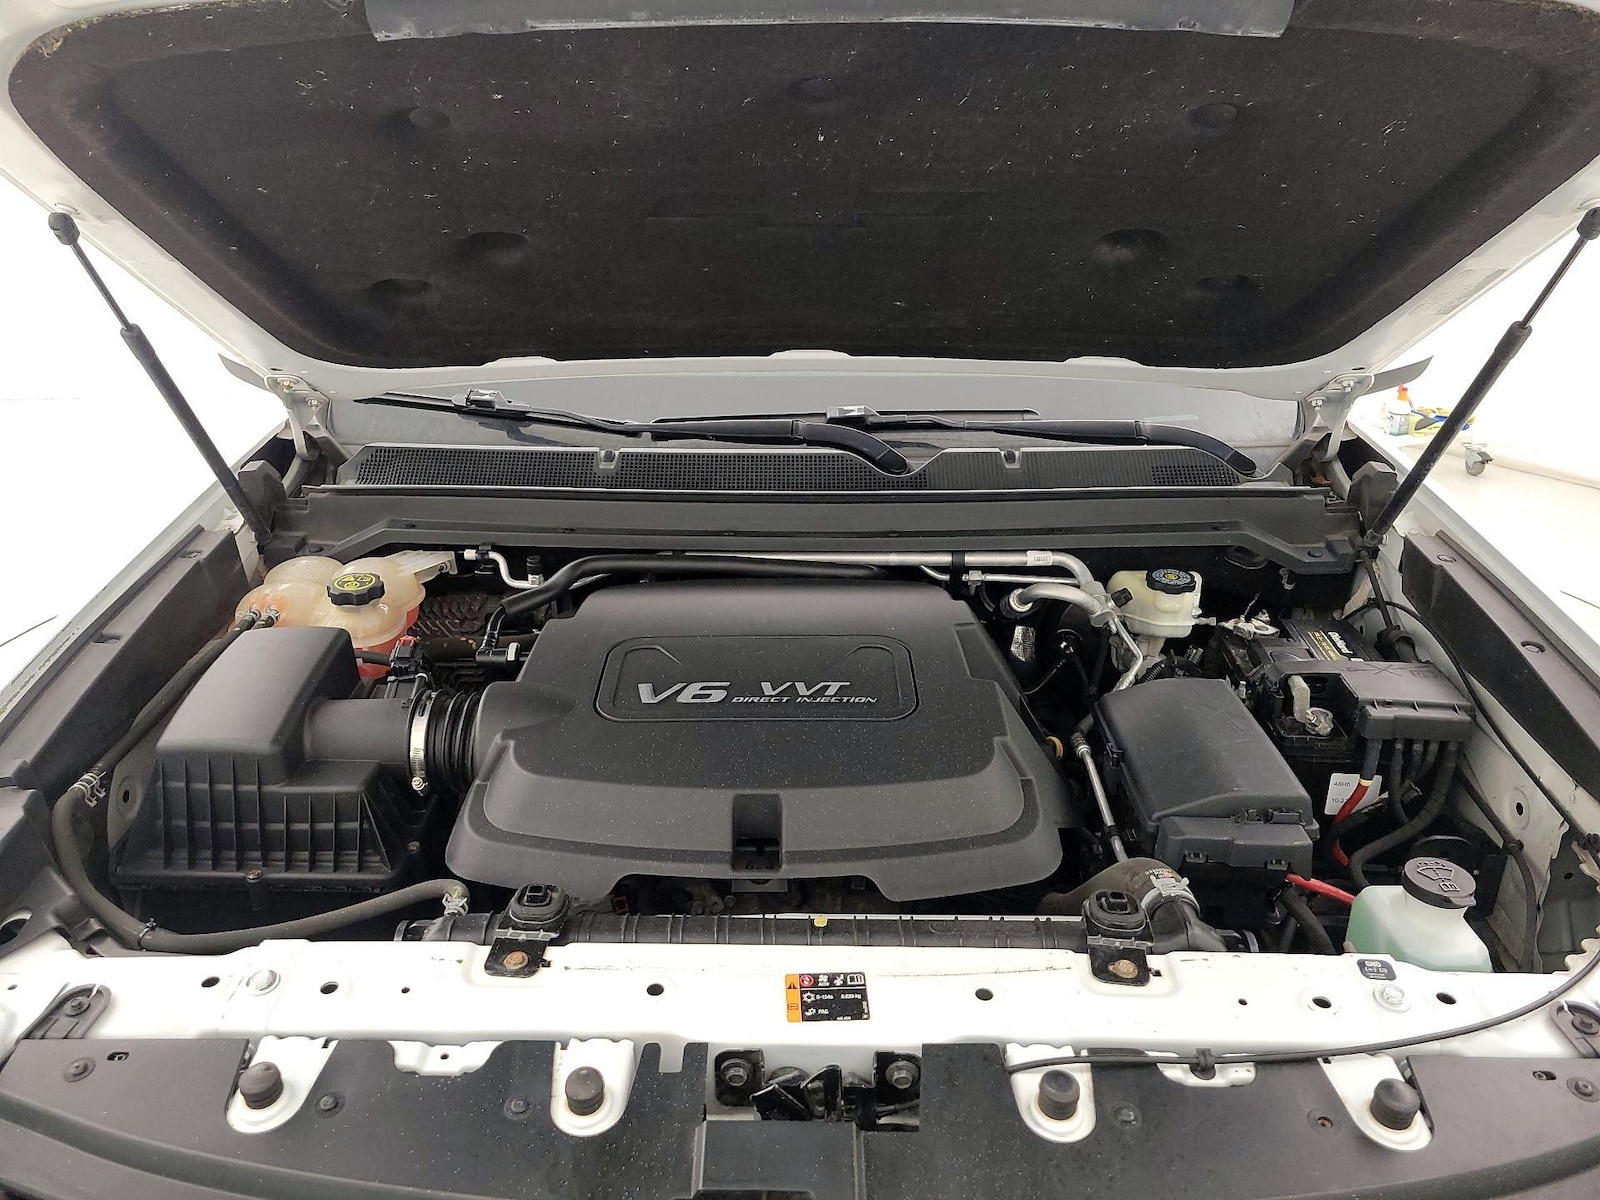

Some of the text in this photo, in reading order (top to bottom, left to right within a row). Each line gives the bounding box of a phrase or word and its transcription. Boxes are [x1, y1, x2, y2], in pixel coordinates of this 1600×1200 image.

[638, 681, 731, 704] V6
[760, 681, 851, 696] VVT
[731, 696, 879, 704] DIRECT INJECTION
